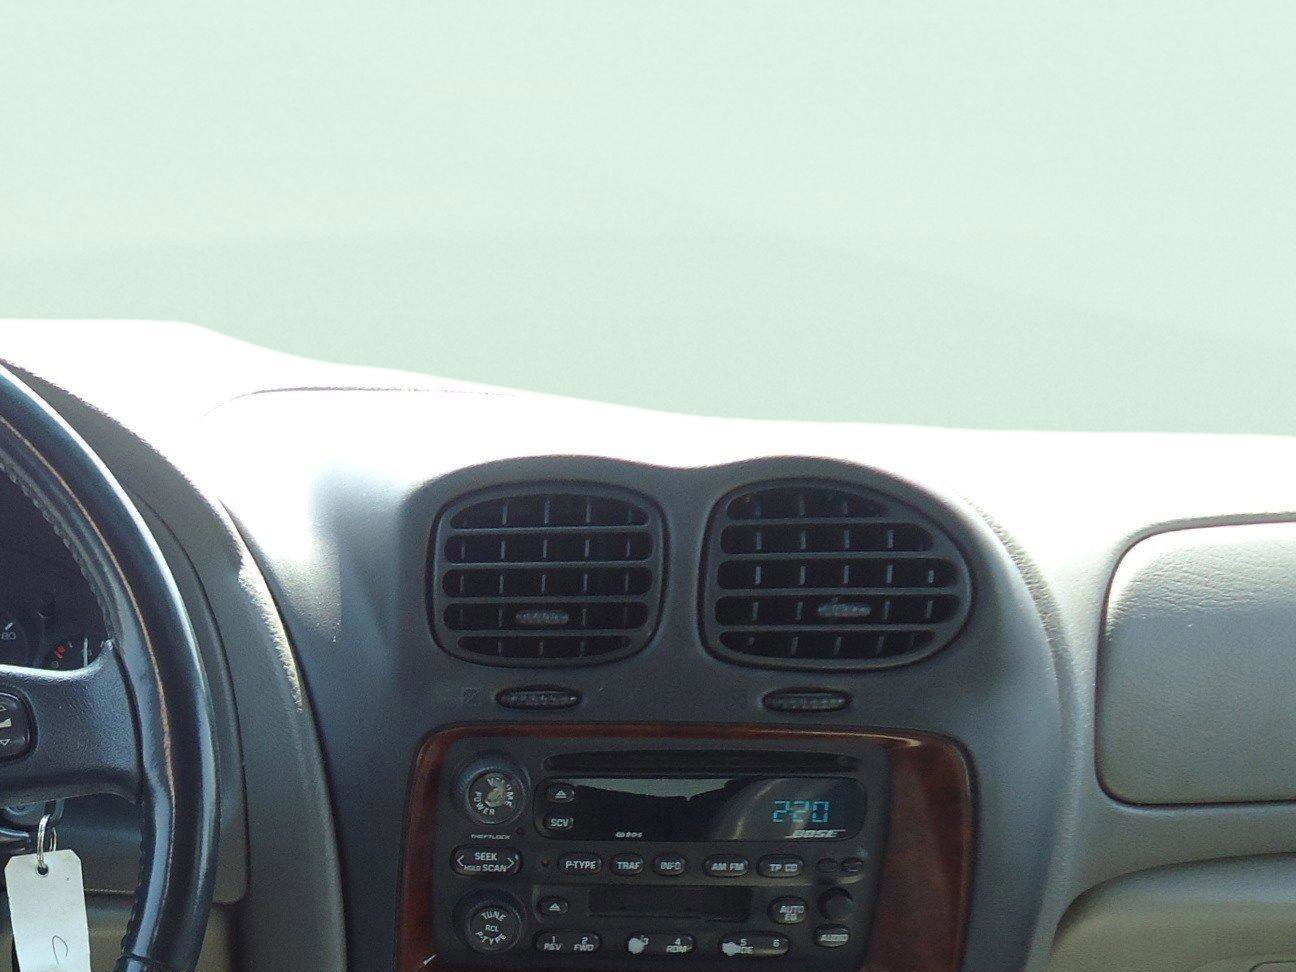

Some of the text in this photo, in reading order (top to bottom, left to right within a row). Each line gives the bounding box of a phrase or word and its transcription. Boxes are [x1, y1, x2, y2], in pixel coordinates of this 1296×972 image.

[473, 791, 495, 815] POWER
[550, 818, 570, 827] SCV
[789, 829, 840, 839] BOSE
[474, 852, 498, 861] SEEK
[482, 864, 507, 872] SCAN
[565, 861, 597, 869] P-TYPE
[617, 861, 641, 870] TRAF
[660, 861, 682, 870] INFO
[710, 862, 745, 871] AM FM
[769, 863, 782, 872] TP
[481, 910, 507, 921] TUNE
[485, 924, 499, 932] RCL
[581, 936, 589, 944] 2
[674, 938, 682, 946] 4
[740, 938, 748, 946] 5
[772, 939, 780, 947] 6
[543, 943, 563, 951] REV
[573, 944, 595, 952] FWD
